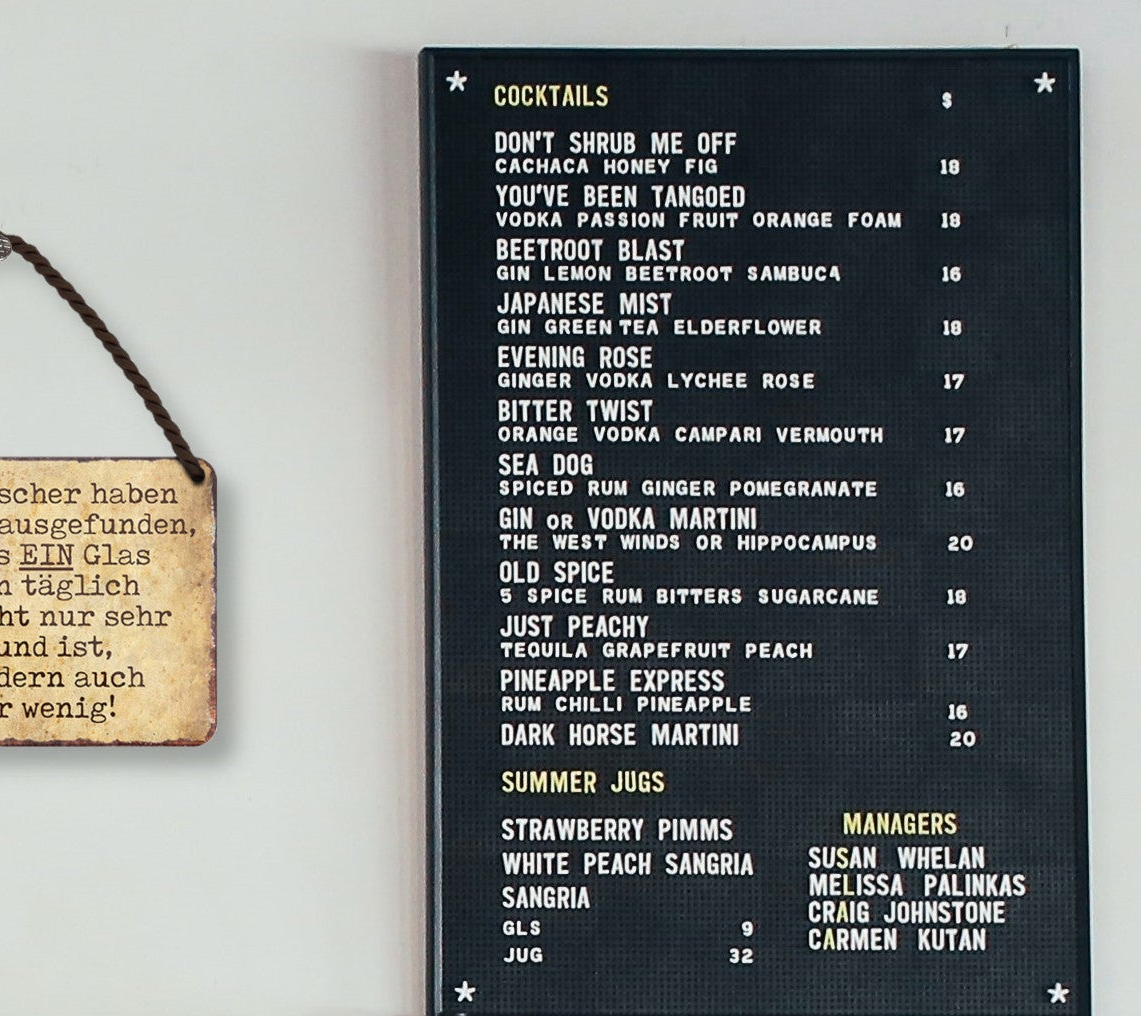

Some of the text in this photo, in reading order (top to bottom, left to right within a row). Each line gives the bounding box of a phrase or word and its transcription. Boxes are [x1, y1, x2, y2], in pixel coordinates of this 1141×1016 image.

[495, 85, 952, 109] COCKTAILS $
[495, 131, 736, 154] DON'T SHRUB ME OFF
[496, 158, 959, 175] CACHACA HONEY FIG 18
[496, 185, 745, 208] YOU'VE BEEN TANGOED
[496, 212, 960, 228] VODKA PASSION FRUIT ORANGE FOAM 18
[497, 239, 684, 261] BEETROOT BLAST
[497, 292, 671, 315] JAPANESE MIST
[498, 319, 961, 335] GIN GREEN TEA ELDERFLOWER 18
[498, 346, 652, 369] EVENING ROSE
[499, 400, 652, 422] BITTER TWIST
[499, 454, 593, 475] SEA DOG
[91, 483, 178, 504] haben
[500, 480, 964, 497] SPICED RUM GINGER POMEGRANATE 16
[500, 507, 756, 530] GIN OR VODKA MARTINI
[19, 544, 74, 567] EIN
[84, 544, 150, 565] Glas
[500, 561, 613, 583] OLD SPICE
[21, 575, 139, 600] täglich
[40, 611, 94, 626] nur
[106, 606, 171, 626] sehr
[500, 615, 648, 638] JUST PEACHY
[58, 636, 111, 659] ist,
[501, 642, 968, 659] TEQUILA GRAPEFRUIT PEACH 17
[75, 667, 145, 687] auch
[501, 669, 724, 692] PINEAPPLE EXPRESS
[22, 695, 115, 723] wenig!
[502, 696, 967, 720] RUM CHILLI PINEAPPLE 16
[502, 723, 976, 747] DARK HORSE MARTINI 20
[502, 771, 664, 793] SUMMER JUGS
[502, 818, 733, 841] STRAWBERRY PIMMS
[844, 813, 957, 835] MANAGERS
[503, 853, 753, 875] WHITE PEACH SANGRIA
[809, 847, 984, 869] SUSAN WHELAN
[810, 874, 1026, 897] MELISSA PALINKAS
[503, 886, 590, 909] SANGRIA
[809, 901, 1005, 923] CRAIG JOHNSTONE
[503, 921, 753, 936] GLS 9
[809, 929, 985, 951] CARMEN KUTAN
[504, 947, 753, 963] JUG 32
